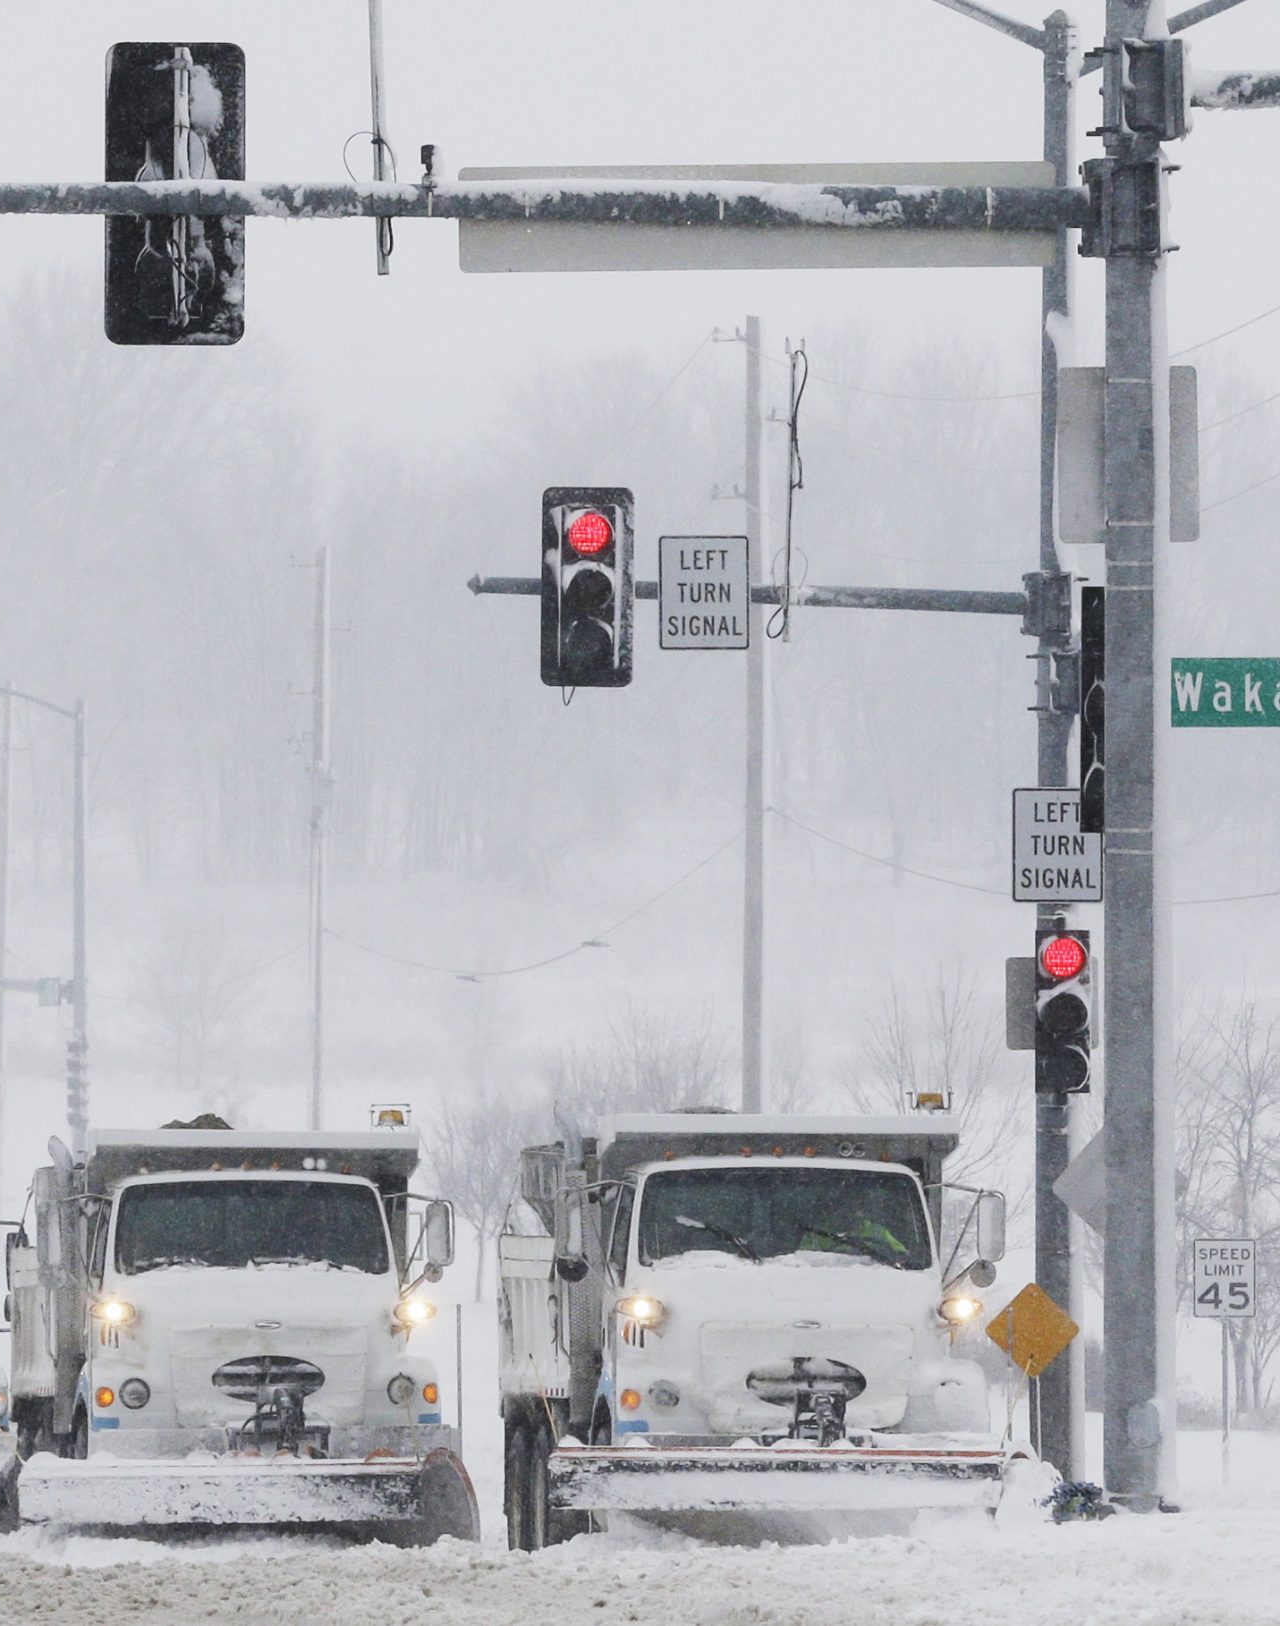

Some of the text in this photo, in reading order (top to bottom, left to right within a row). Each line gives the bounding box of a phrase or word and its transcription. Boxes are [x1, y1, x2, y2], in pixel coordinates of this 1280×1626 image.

[680, 549, 728, 570] LEFT
[677, 583, 731, 603] TURN
[668, 615, 743, 636] SIGNAL
[1034, 802, 1080, 823] LEFT
[1031, 835, 1085, 856] TURN
[1021, 868, 1097, 889] SIGNAL
[1199, 1248, 1251, 1260] SPEED
[1204, 1264, 1245, 1276] LIMIT
[1197, 1282, 1250, 1310] 45
